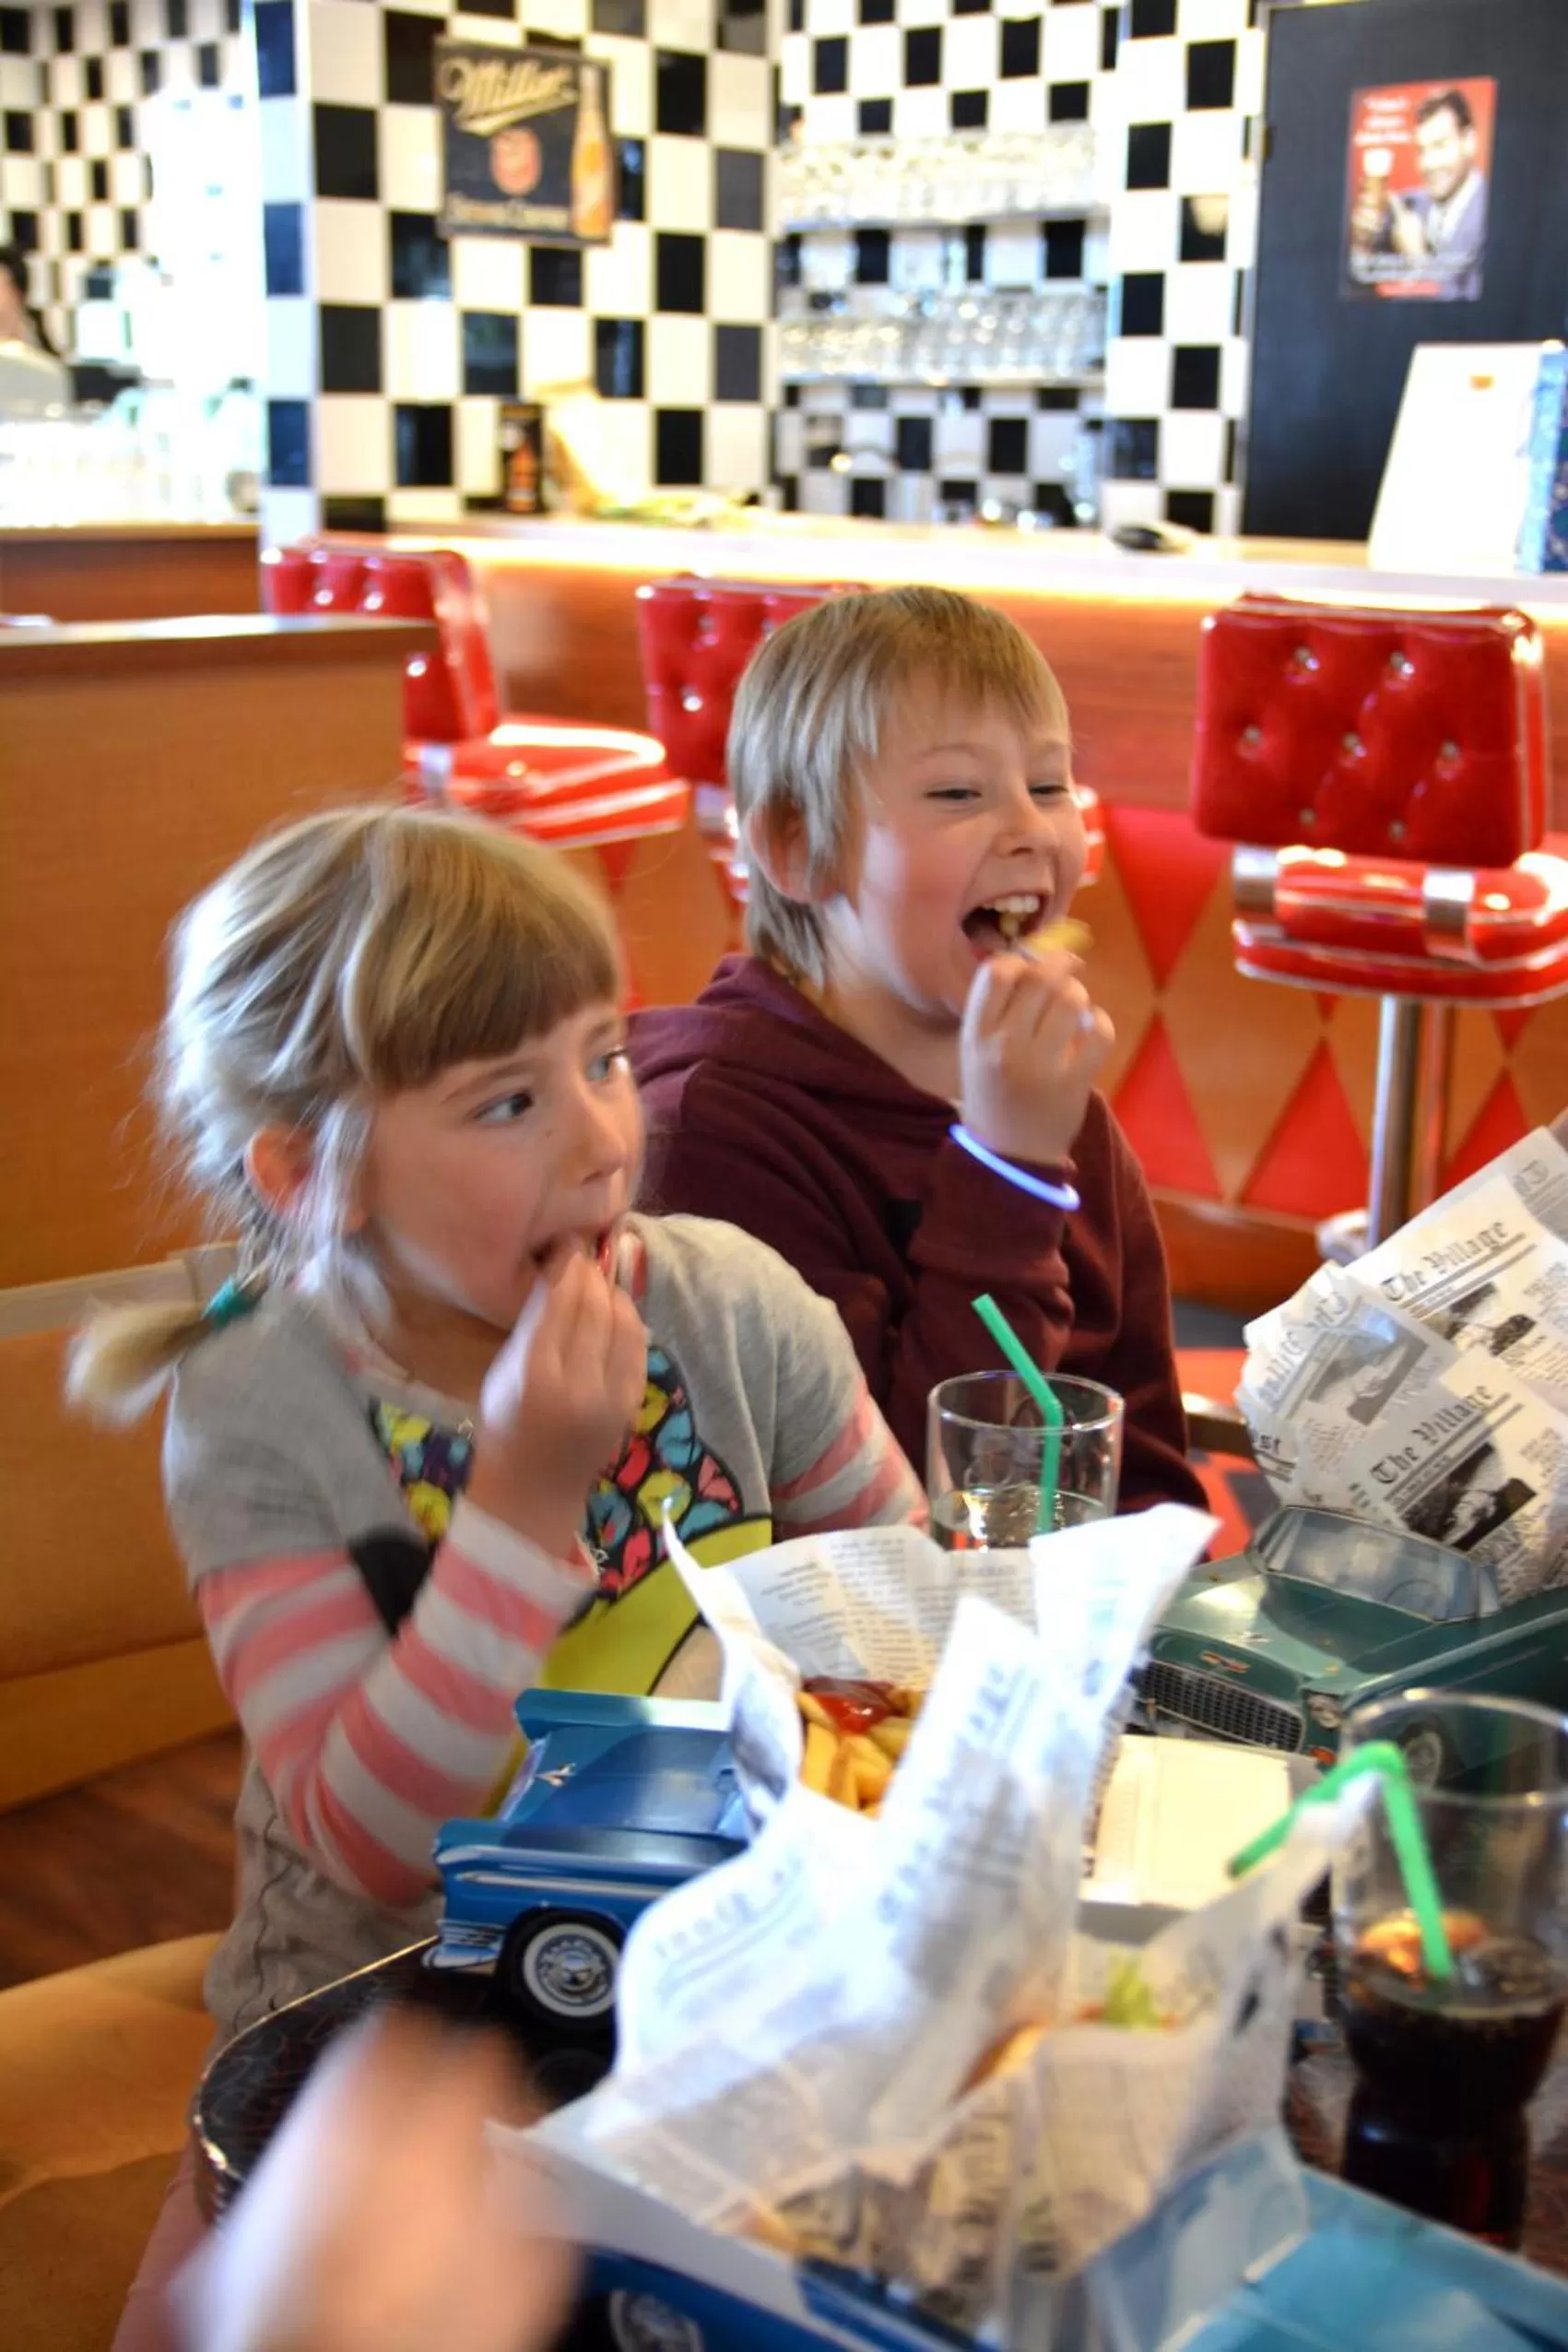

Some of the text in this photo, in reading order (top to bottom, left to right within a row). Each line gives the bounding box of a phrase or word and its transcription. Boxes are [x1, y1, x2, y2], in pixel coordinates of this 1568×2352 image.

[438, 55, 581, 121] Miller
[1382, 1222, 1507, 1302] The Village
[1370, 1446, 1420, 1484] The
[1411, 1385, 1493, 1446] Village
